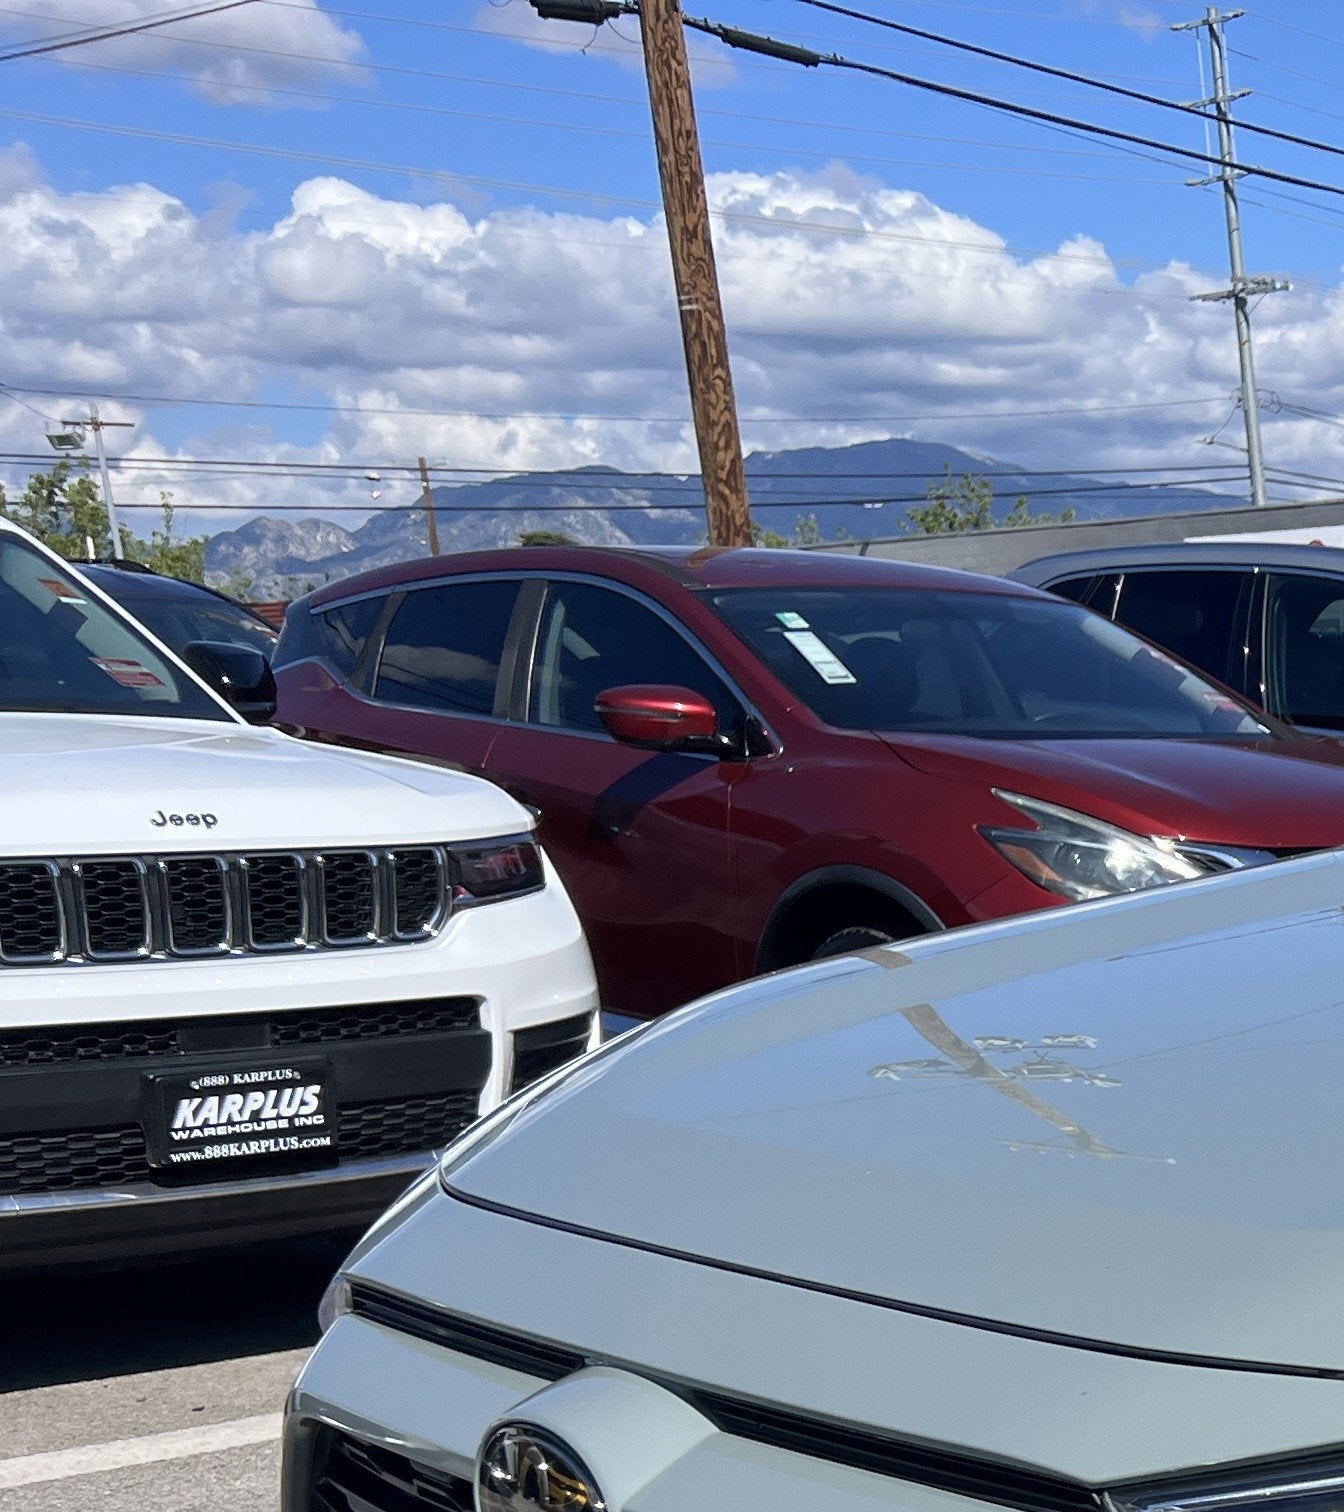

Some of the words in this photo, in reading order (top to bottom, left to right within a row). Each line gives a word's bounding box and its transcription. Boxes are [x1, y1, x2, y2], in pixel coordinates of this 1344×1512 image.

[150, 810, 218, 829] Jeep
[199, 1074, 230, 1087] (888)
[233, 1069, 293, 1084] KARPLUS
[171, 1085, 322, 1128] KARPLUS
[170, 1118, 289, 1141] WAREHOUSE
[294, 1114, 325, 1127] INC
